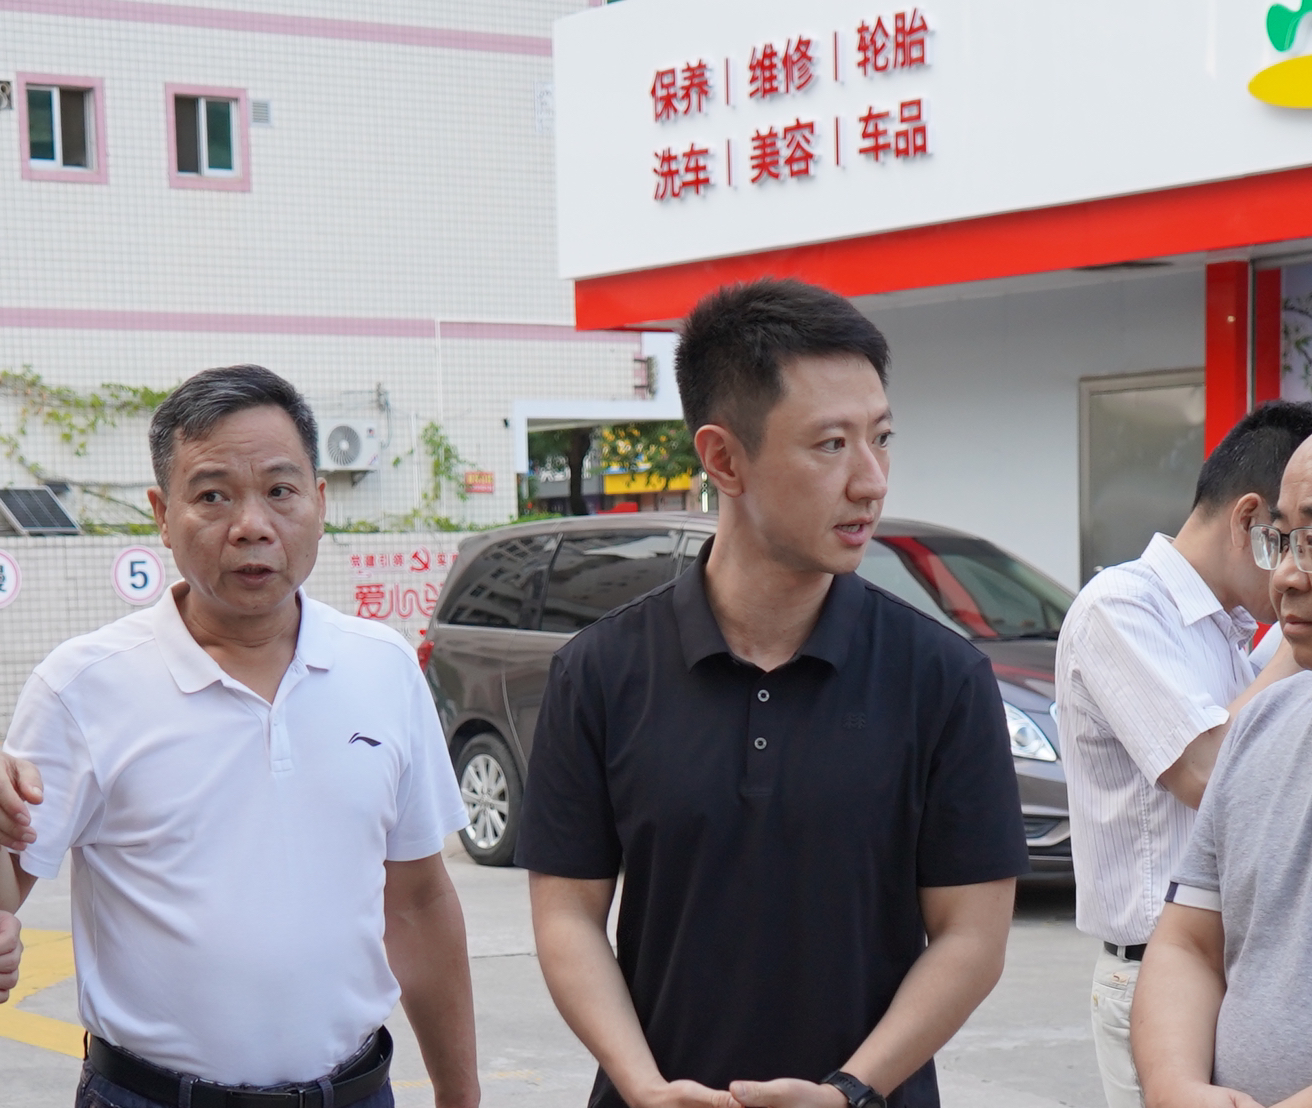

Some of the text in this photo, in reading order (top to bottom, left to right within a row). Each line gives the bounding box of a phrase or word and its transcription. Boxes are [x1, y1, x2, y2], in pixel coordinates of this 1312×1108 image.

[650, 8, 929, 122] 保养 维修 轮胎
[653, 98, 928, 201] 洗车 美容 车品
[129, 560, 149, 590] 5
